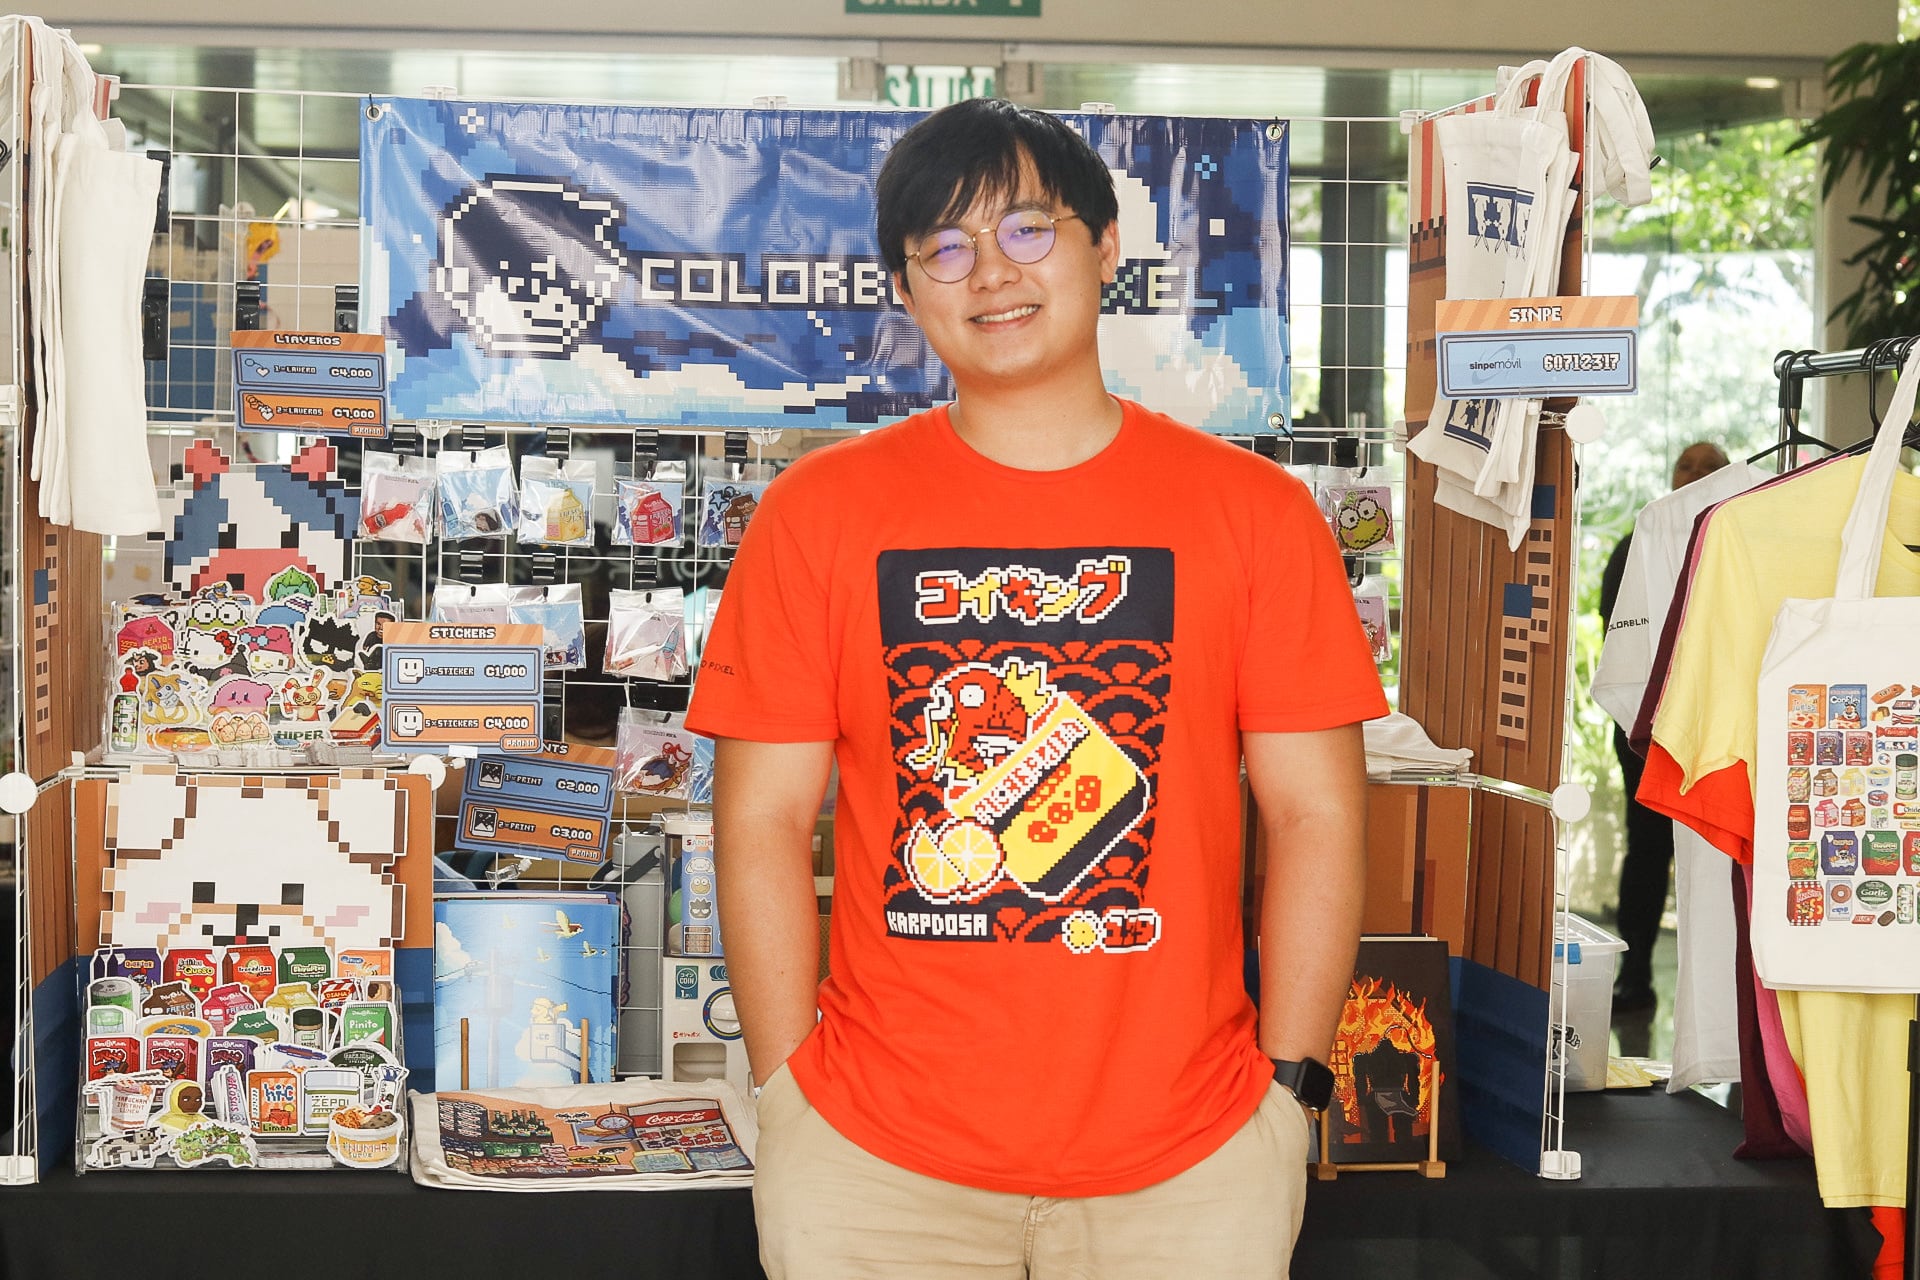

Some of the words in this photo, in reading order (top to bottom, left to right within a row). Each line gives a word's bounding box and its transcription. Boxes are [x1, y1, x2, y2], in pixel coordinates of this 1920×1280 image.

[641, 258, 904, 305] COLORB
[1102, 266, 1218, 307] XEL
[1509, 306, 1562, 323] SINPE
[1543, 353, 1620, 372] 60712317
[915, 555, 1131, 626] コイキング
[430, 627, 495, 638] STICKERS
[543, 743, 569, 754] NTS
[349, 1020, 378, 1029] Pinito
